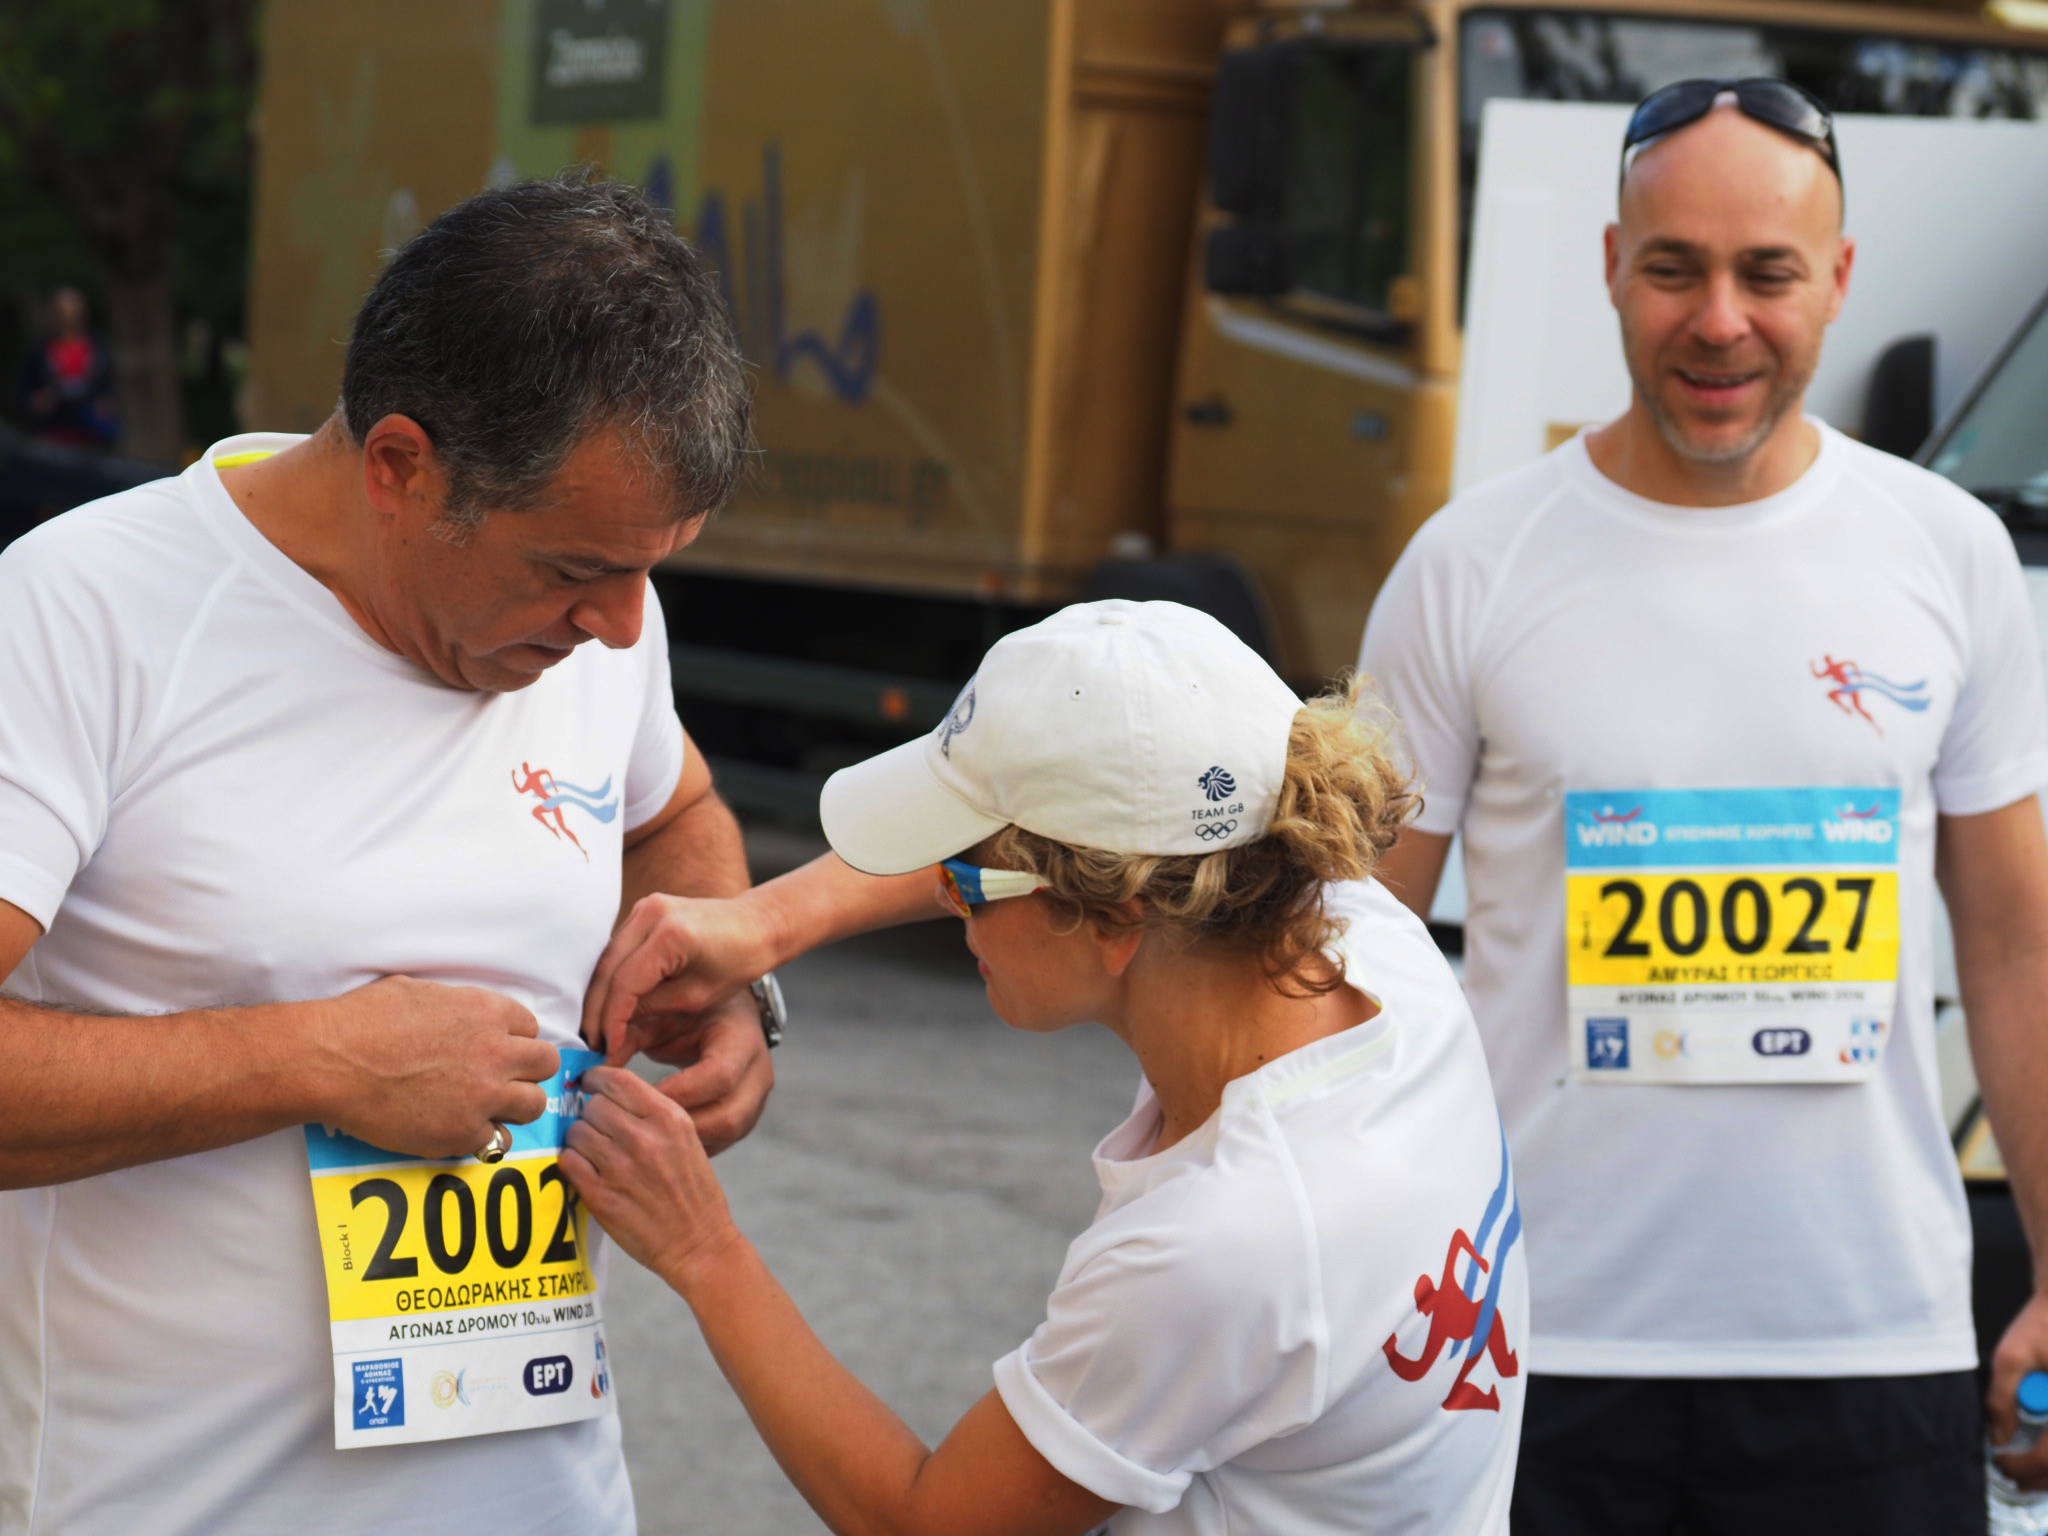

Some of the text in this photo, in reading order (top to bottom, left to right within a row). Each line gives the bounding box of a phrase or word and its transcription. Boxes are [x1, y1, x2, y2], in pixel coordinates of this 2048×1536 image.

[1192, 803, 1244, 819] TEAM GB
[1577, 821, 1659, 847] WIND
[1822, 818, 1894, 844] WIND
[1601, 876, 1875, 957] 20027
[339, 1233, 353, 1271] Block
[396, 1277, 532, 1312] ΘΕΟΔΩΡΑΚΗΣ
[389, 1319, 454, 1341] ΑΓΩΝΑΣ
[458, 1311, 518, 1334] ΔΡΟΜΟΥ
[553, 1303, 583, 1322] WIND
